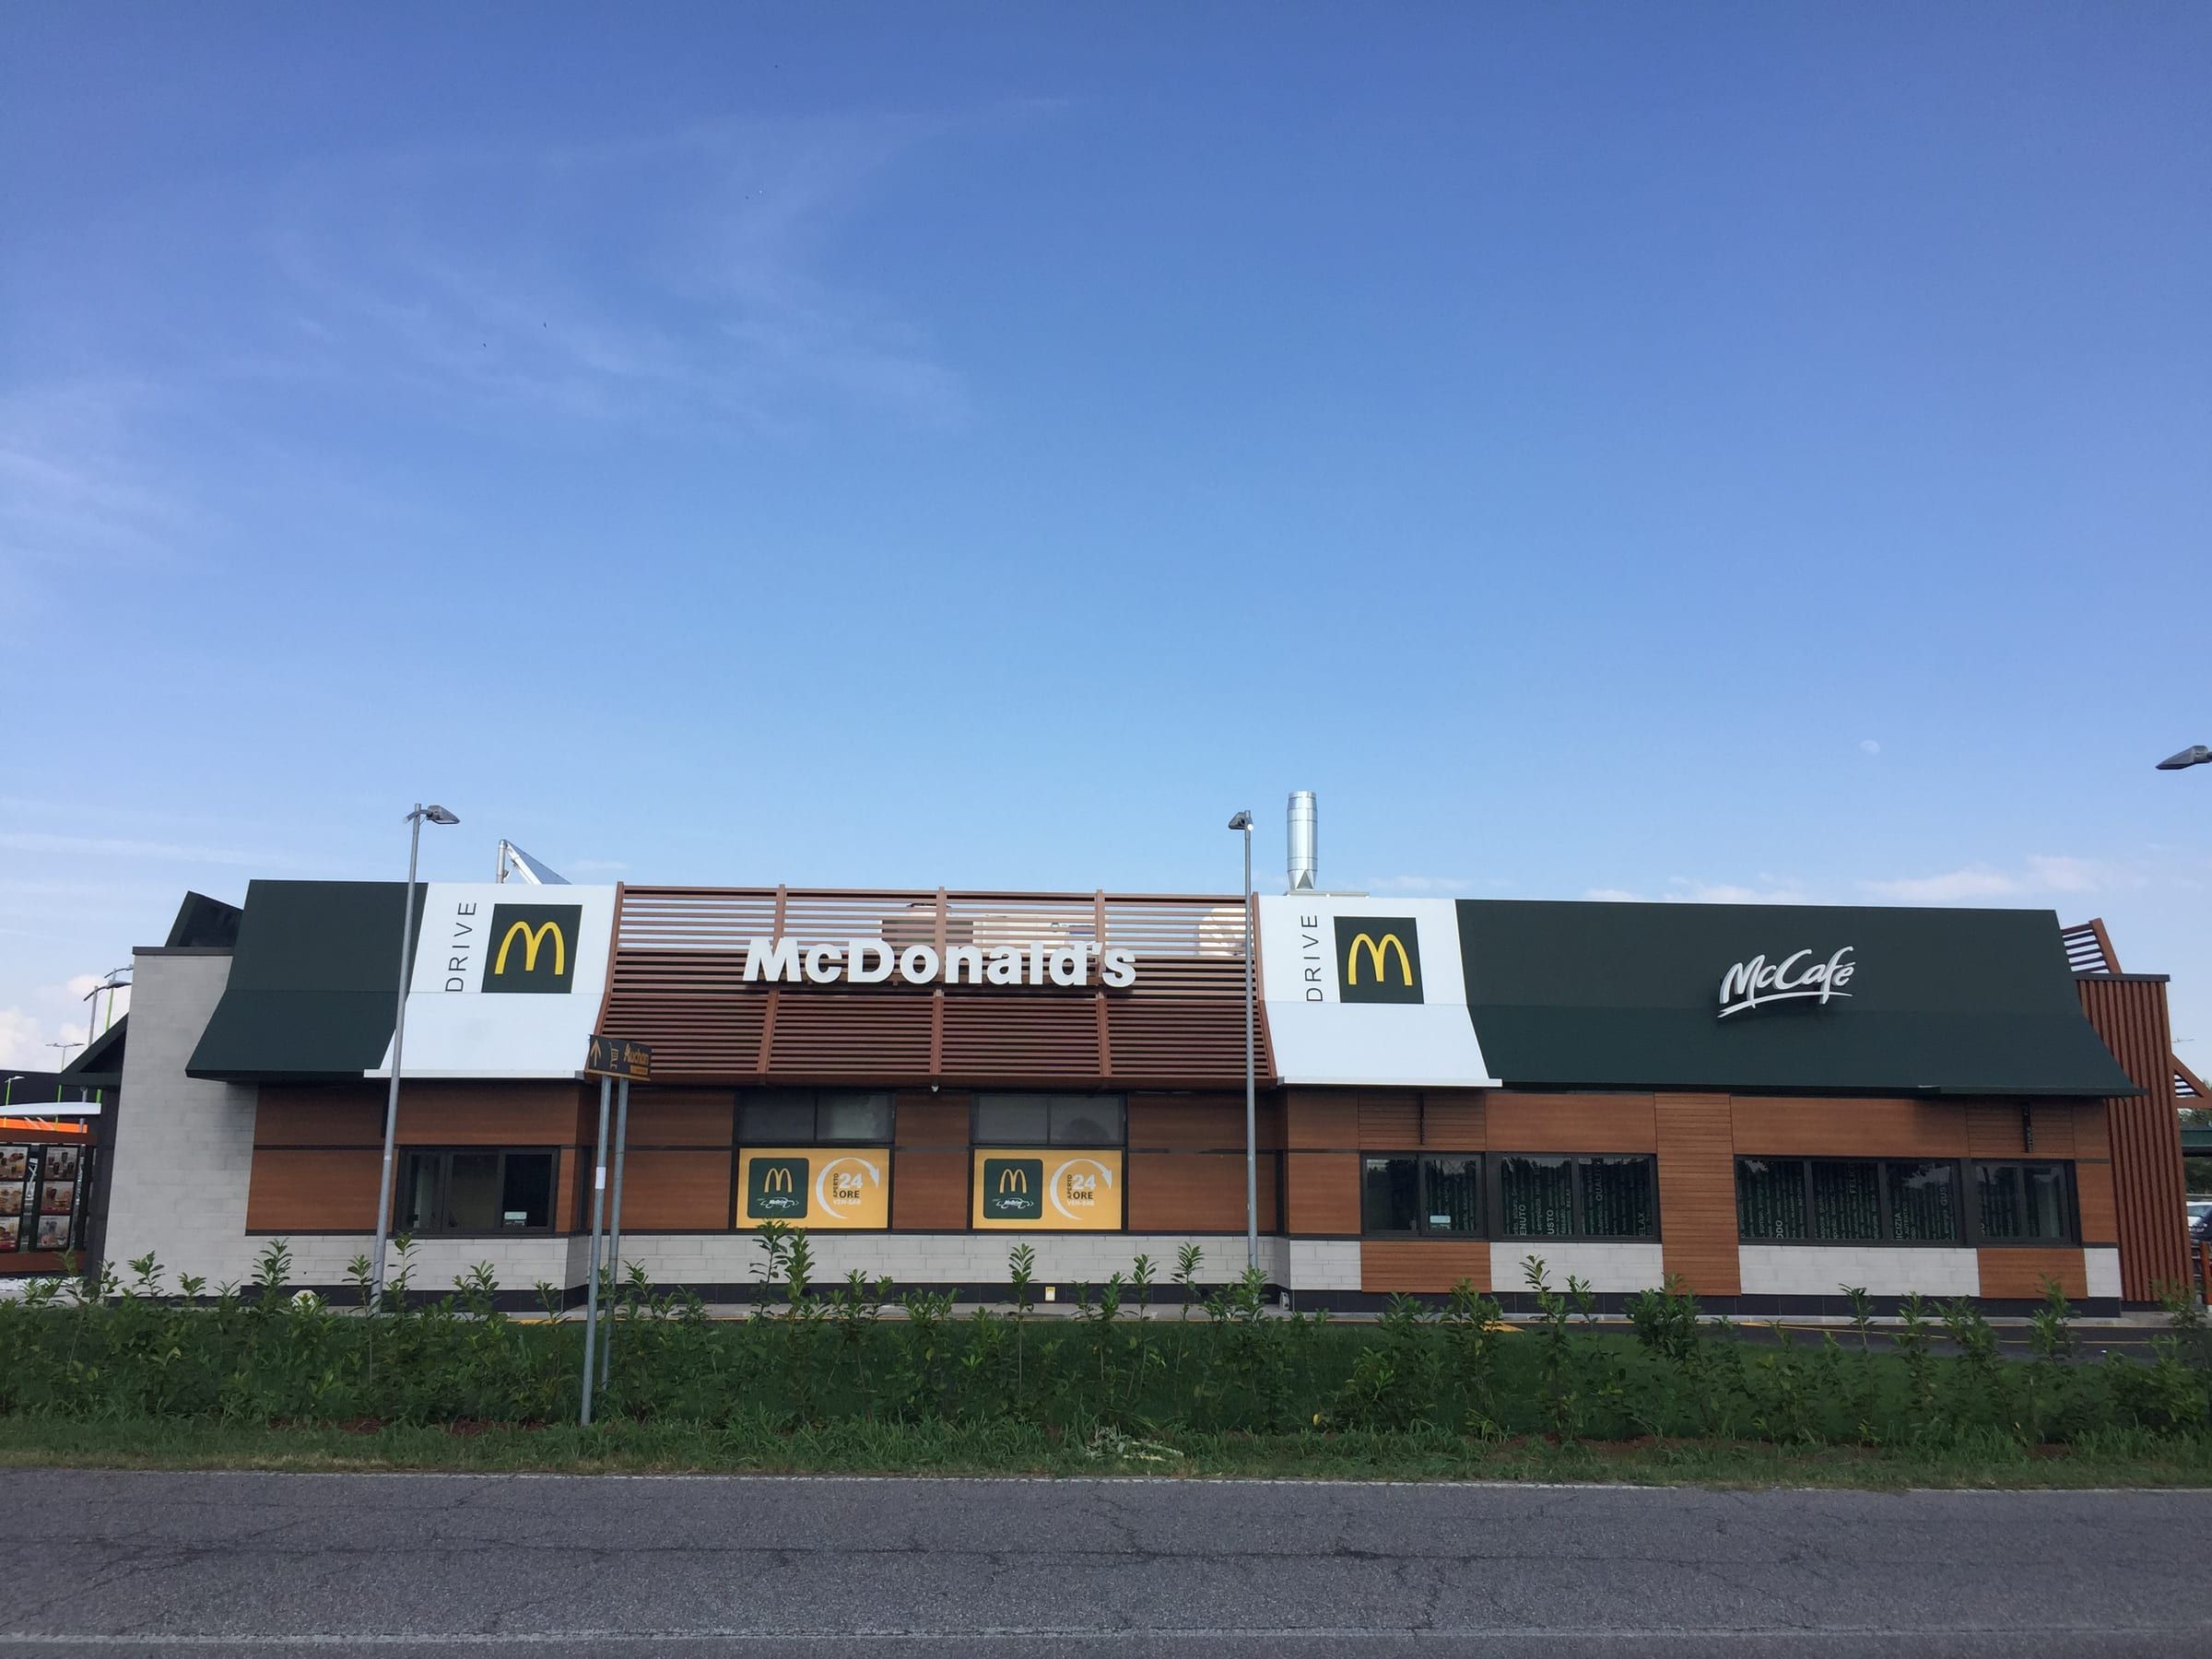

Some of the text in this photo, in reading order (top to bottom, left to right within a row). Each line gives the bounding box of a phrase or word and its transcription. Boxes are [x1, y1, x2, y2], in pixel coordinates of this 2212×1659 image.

[444, 902, 477, 992] DRIVE
[742, 936, 1136, 988] McDonald's
[1300, 915, 1324, 1002] DRIVE
[1718, 946, 1856, 1010] McCafé
[839, 1190, 860, 1199] ORE
[840, 1172, 864, 1189] 24
[1073, 1173, 1097, 1191] 24
[1073, 1191, 1094, 1199] ORE
